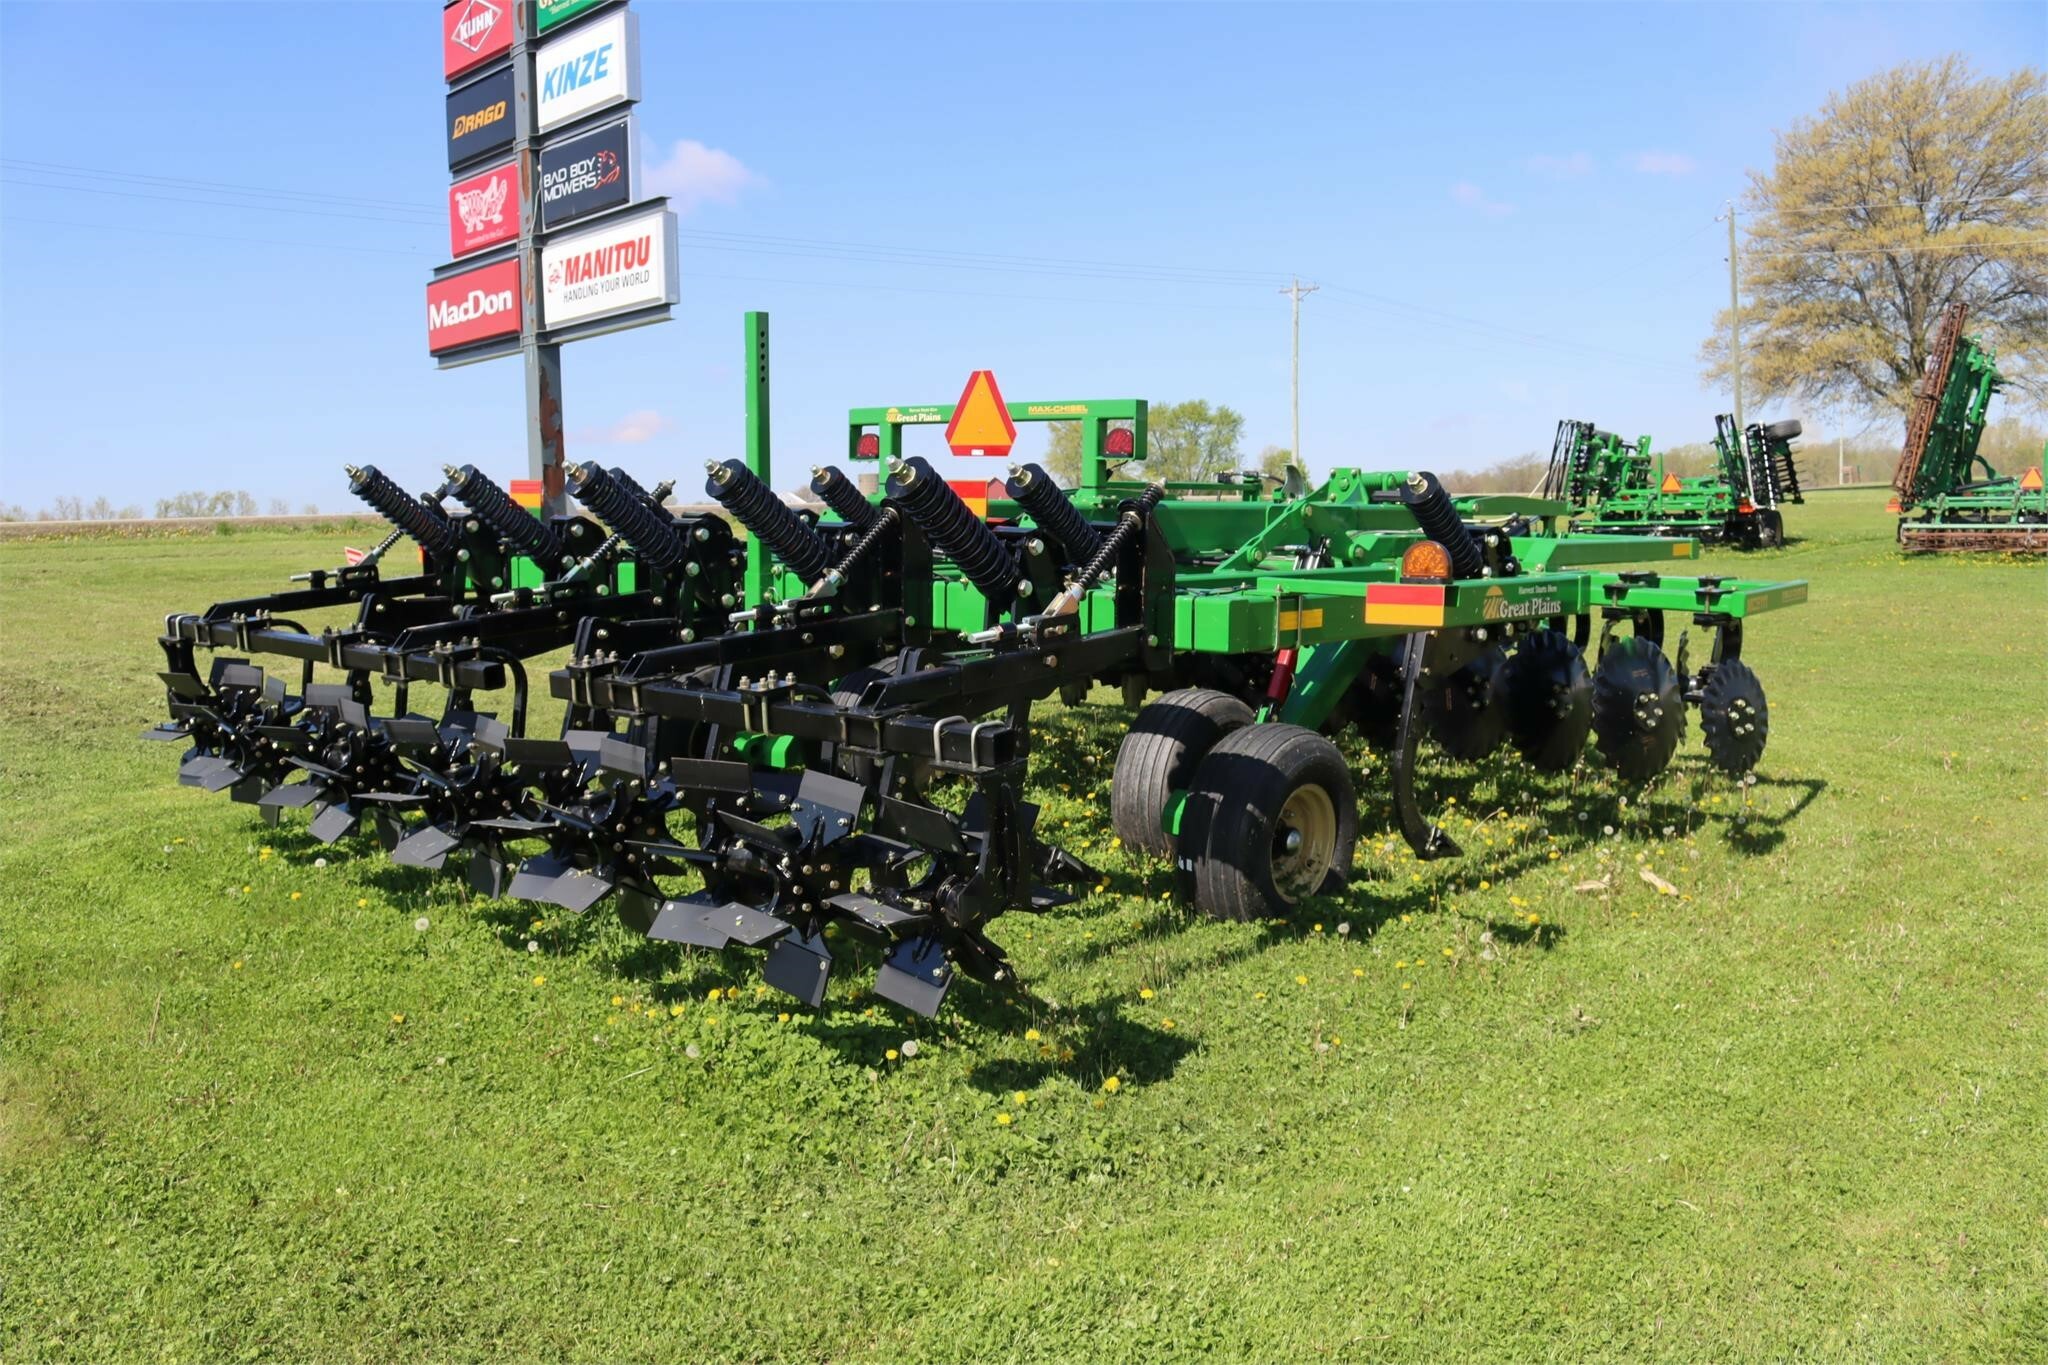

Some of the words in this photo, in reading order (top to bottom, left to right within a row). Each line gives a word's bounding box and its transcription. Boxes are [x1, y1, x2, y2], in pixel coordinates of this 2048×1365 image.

[459, 9, 493, 41] KUHN
[542, 43, 613, 104] KINZE
[452, 101, 506, 140] DRAGO
[543, 168, 567, 188] BAD
[570, 157, 596, 178] BOY
[544, 172, 597, 203] MOWERS
[564, 235, 651, 286] MANITOU
[563, 283, 599, 304] HANDLING
[600, 277, 620, 293] YOUR
[622, 270, 650, 288] WORLD
[429, 289, 513, 331] MacDon
[896, 414, 918, 422] Great
[918, 412, 942, 422] Plains
[1500, 600, 1530, 618] Great
[1531, 597, 1561, 615] Plains
